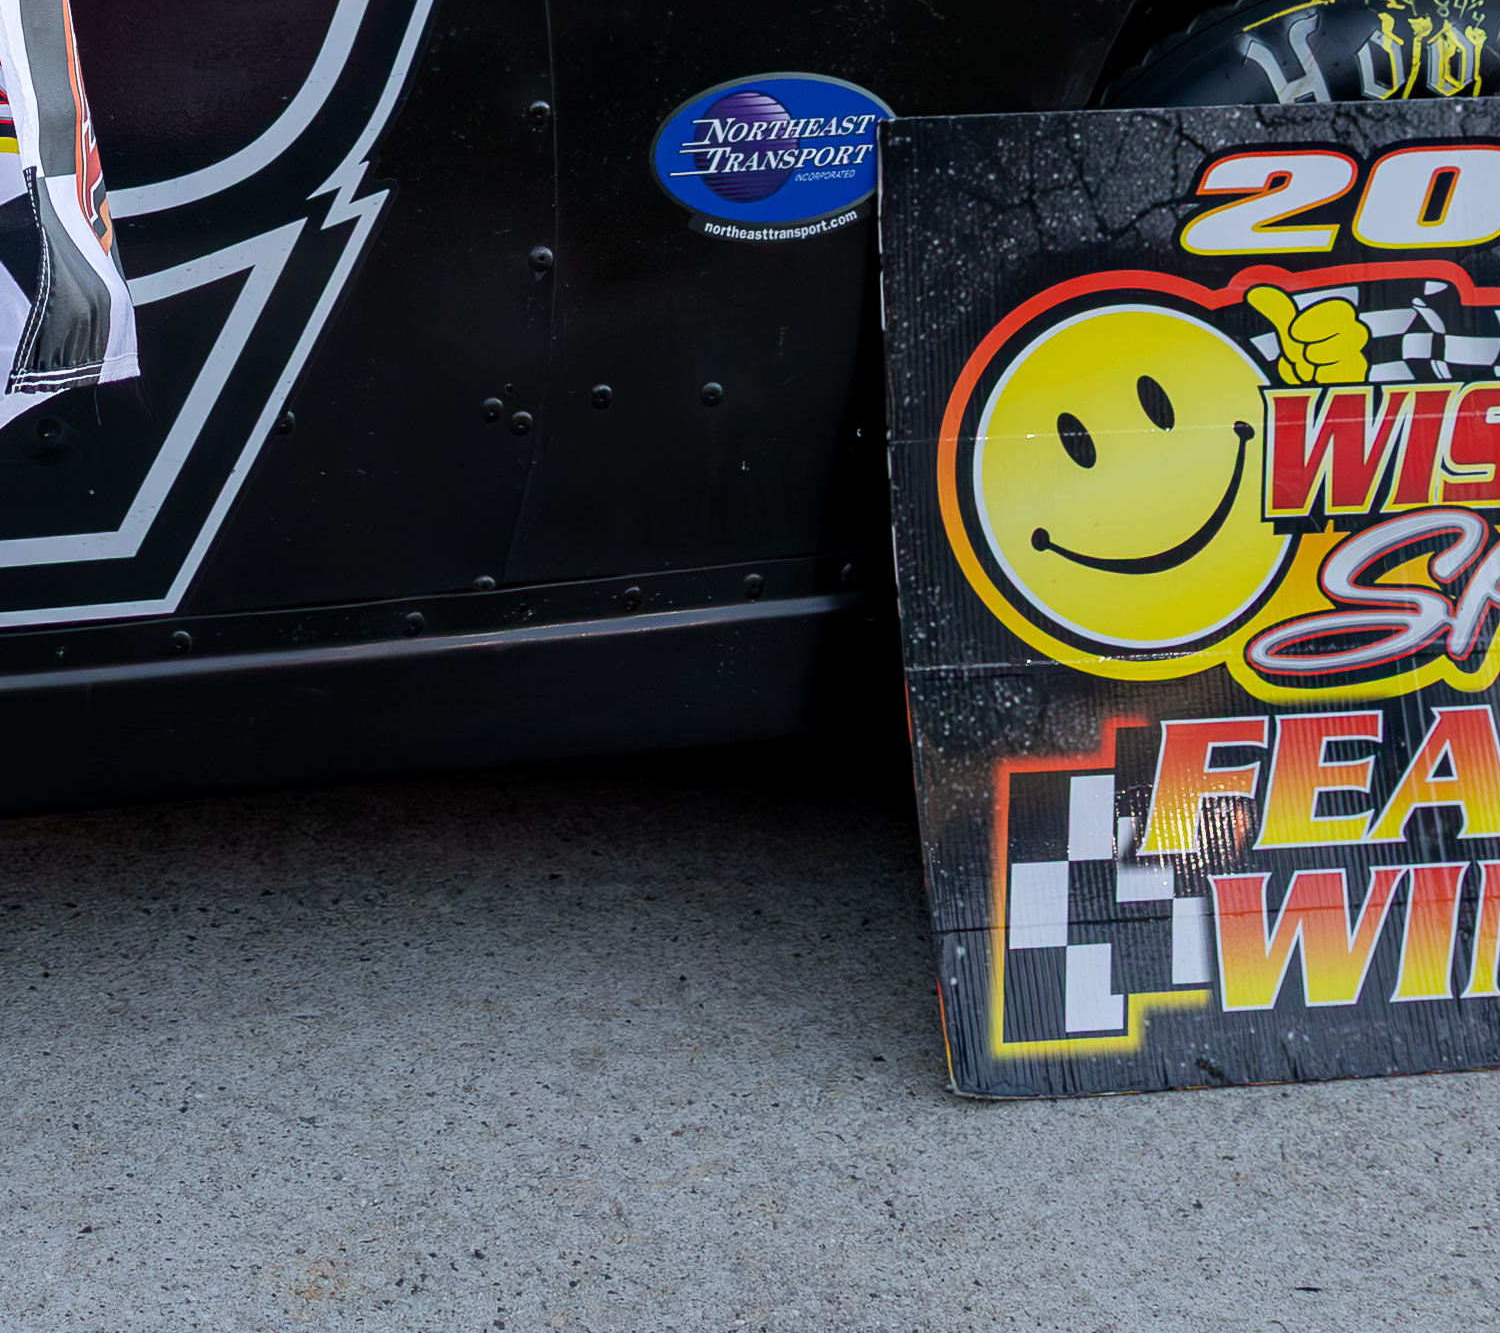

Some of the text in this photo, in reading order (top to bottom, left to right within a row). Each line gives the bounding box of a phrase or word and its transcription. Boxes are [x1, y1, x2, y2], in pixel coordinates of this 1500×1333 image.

[702, 114, 876, 145] NORTHEAST
[704, 144, 874, 175] TRANSPORT
[794, 169, 856, 182] INCORPORATED
[704, 210, 859, 241] northeasttransport.com
